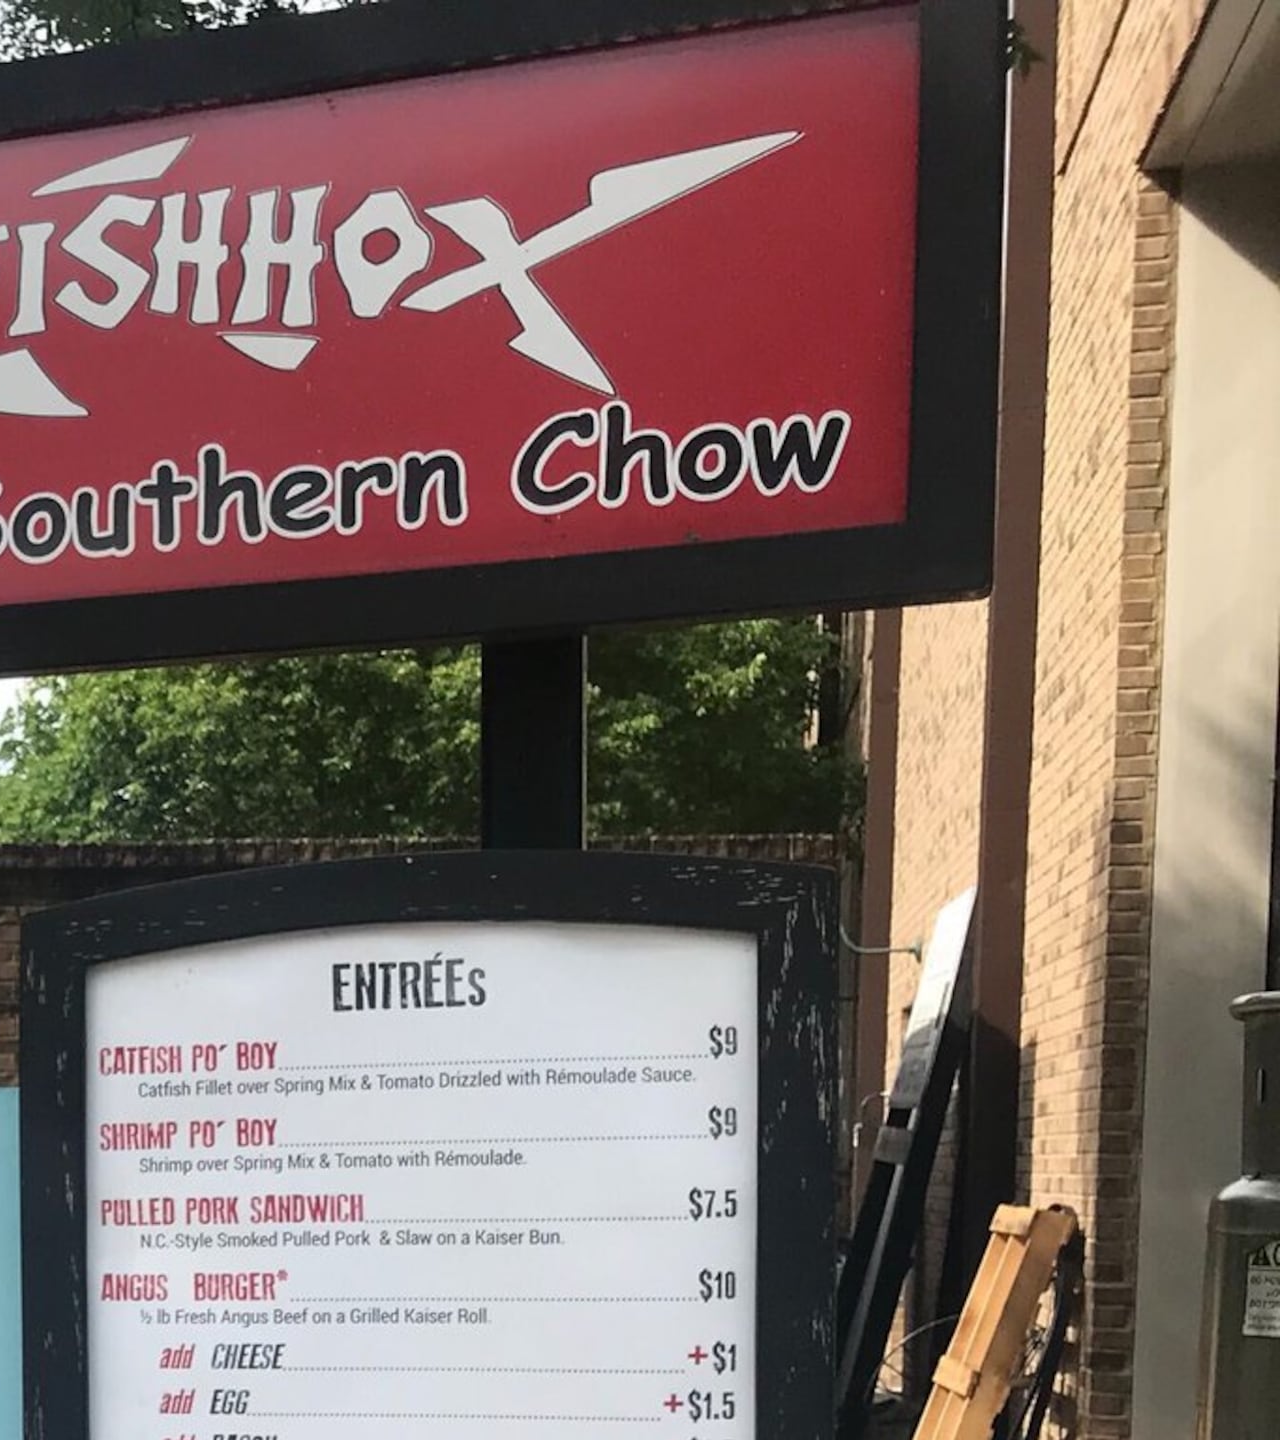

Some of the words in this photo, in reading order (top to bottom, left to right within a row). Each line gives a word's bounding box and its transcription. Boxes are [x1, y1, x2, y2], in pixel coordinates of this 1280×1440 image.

[513, 402, 849, 514] Chow
[100, 1046, 182, 1075] CATFISH
[237, 1042, 277, 1071] BOY
[709, 1025, 737, 1059] $9
[138, 1080, 191, 1098] Catfish
[196, 1079, 232, 1095] Fillet
[237, 1082, 270, 1094] over
[274, 1077, 324, 1096] Spring
[329, 1076, 356, 1091] Mix
[361, 1075, 372, 1090] &
[377, 1074, 434, 1090] Tomato
[439, 1070, 501, 1088] Drizzled
[507, 1069, 540, 1086] with
[546, 1067, 636, 1085] Rémoulade
[642, 1067, 696, 1082] Sauce.
[101, 1197, 175, 1226] PULLED
[186, 1197, 238, 1225] PORK
[251, 1194, 363, 1223] SANDWICH
[689, 1187, 737, 1221] $7.5
[101, 1273, 167, 1301] ANGUS
[699, 1269, 736, 1302] $10
[160, 1344, 195, 1369] add
[212, 1344, 285, 1369] CHEESE
